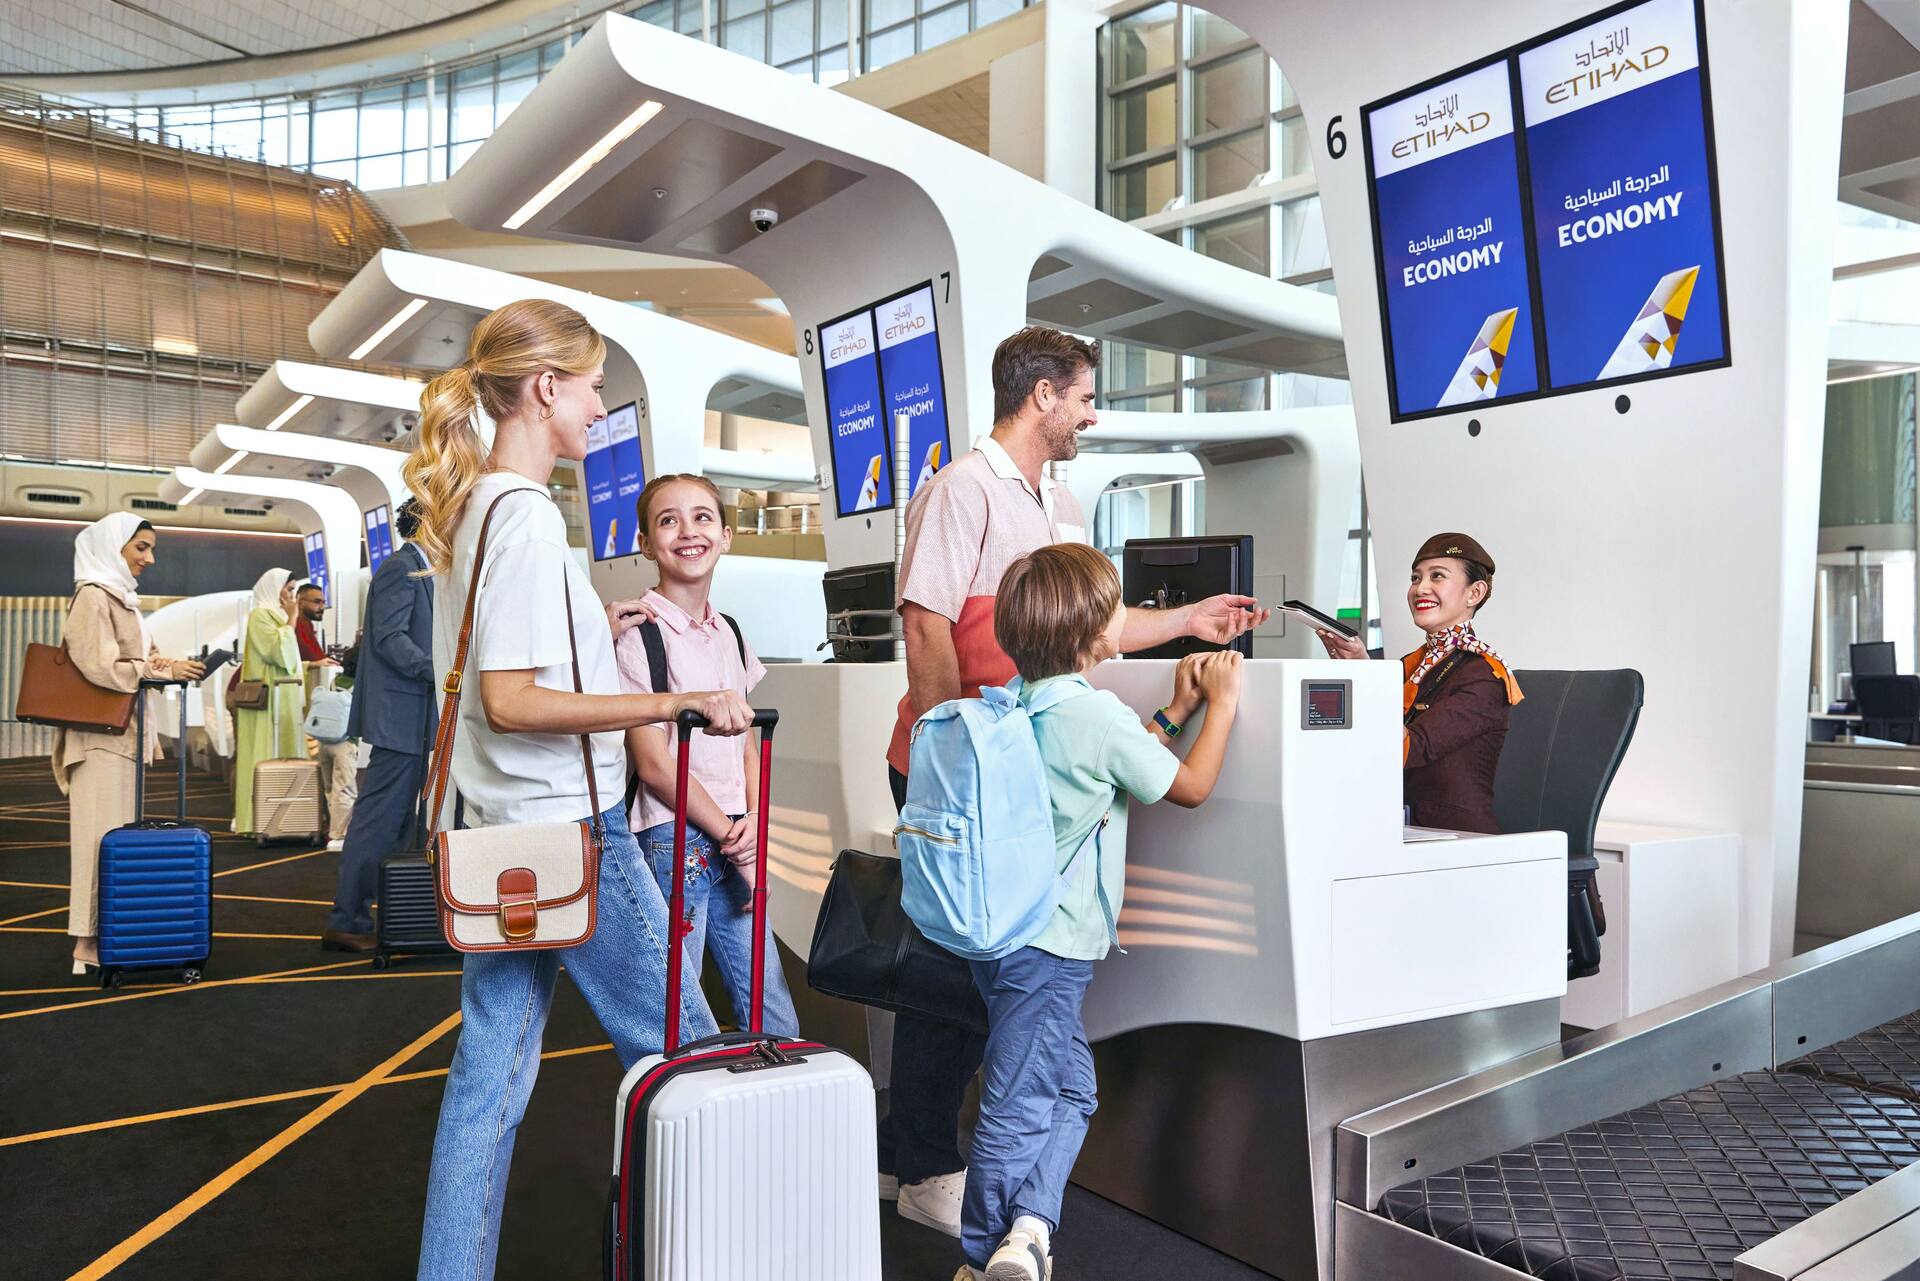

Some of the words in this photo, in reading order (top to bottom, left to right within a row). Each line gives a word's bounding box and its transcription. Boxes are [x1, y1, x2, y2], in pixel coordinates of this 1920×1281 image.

[1545, 45, 1670, 104] ETIHAD
[1326, 114, 1347, 160] 6
[1391, 111, 1491, 159] ETIHAD
[1624, 164, 1670, 193] الدرجة
[1564, 179, 1622, 212] السياحية
[1456, 217, 1493, 242] الدرجة
[1558, 191, 1683, 248] ECONOMY
[1408, 228, 1455, 256] السياحية
[1403, 241, 1504, 287] ECONOMY
[940, 271, 951, 304] 7
[803, 328, 814, 355] 8
[885, 316, 926, 340] ETIHAD
[830, 338, 867, 360] ETIHAD
[838, 414, 875, 437] ECONOMY
